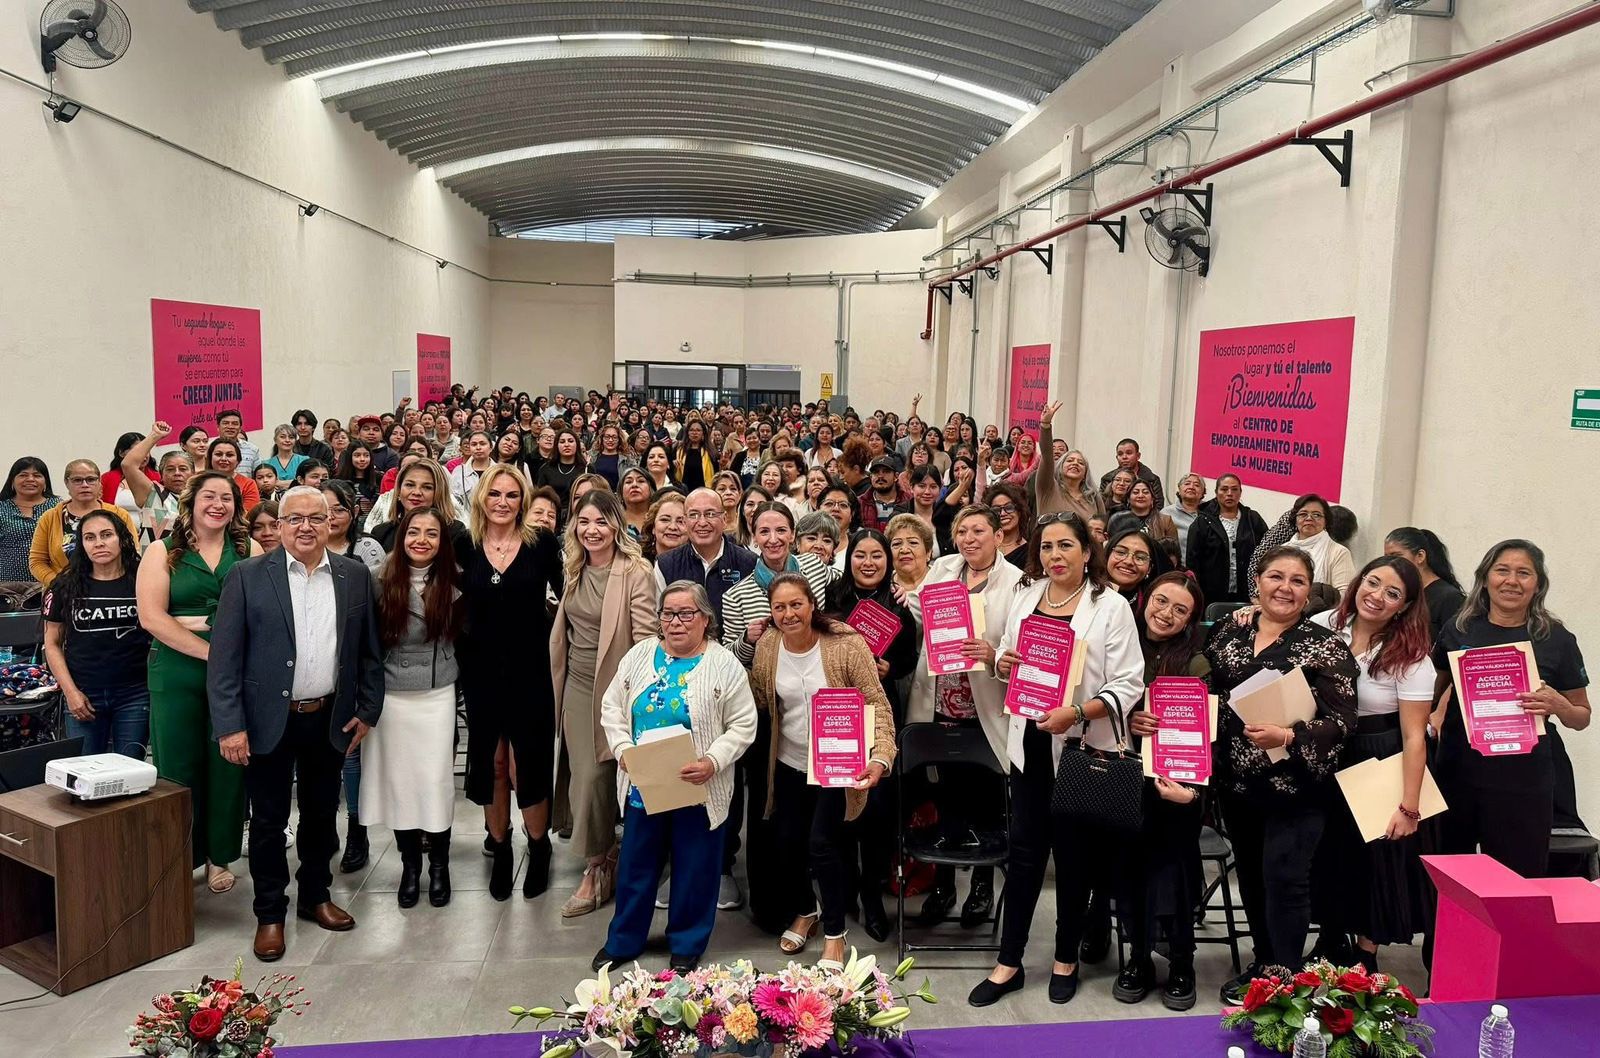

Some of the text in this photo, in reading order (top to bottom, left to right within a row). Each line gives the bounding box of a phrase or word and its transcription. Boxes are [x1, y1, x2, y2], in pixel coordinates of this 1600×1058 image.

[172, 312, 235, 336] Tu segundo hogar es
[198, 336, 216, 348] aquel
[217, 336, 236, 346] donde
[1214, 340, 1295, 357] Nosotros ponemos el
[178, 351, 201, 368] mujeres
[185, 368, 243, 380] se encuentran para
[1244, 360, 1332, 377] lugar y tú el talento
[1223, 373, 1316, 415] ¡Bienvenidas
[1233, 417, 1293, 434] al CENTRO DE
[1211, 433, 1319, 458] EMPODERAMIENTO PARA
[1231, 454, 1292, 476] LAS MUJERES!
[933, 611, 960, 620] ESPECIAL
[856, 623, 879, 642] ESPECIAL
[860, 621, 881, 636] ACCESO
[1028, 648, 1059, 660] ESPECIAL
[1031, 644, 1058, 654] ACCESO
